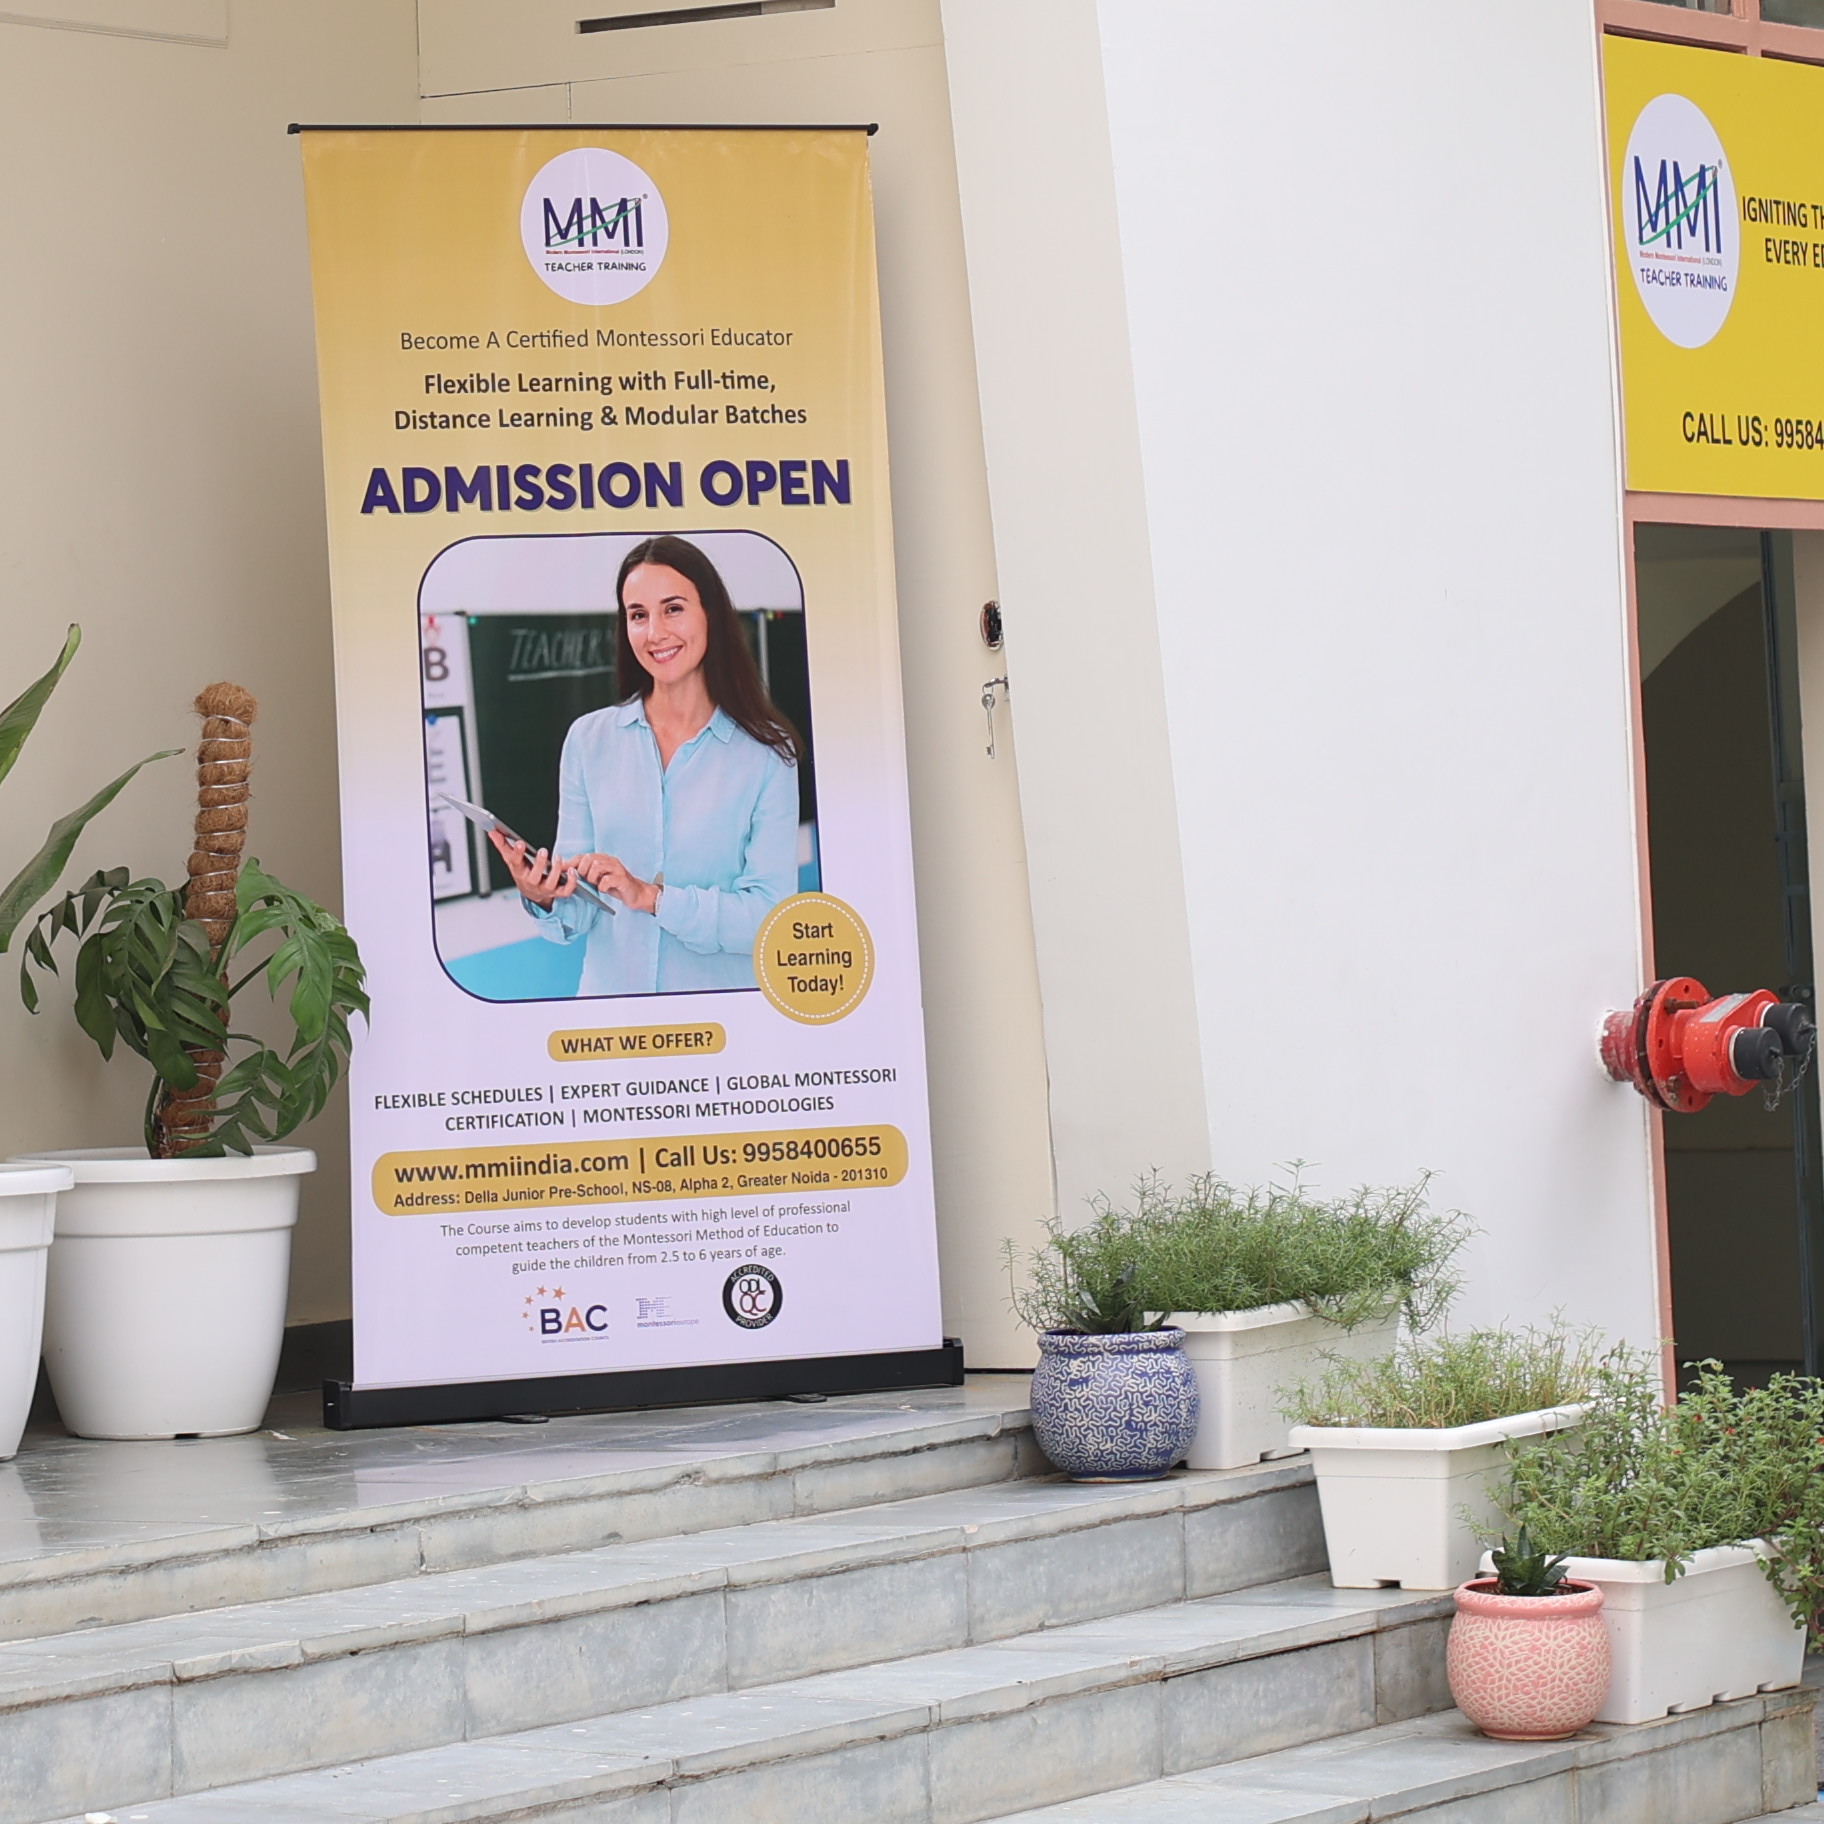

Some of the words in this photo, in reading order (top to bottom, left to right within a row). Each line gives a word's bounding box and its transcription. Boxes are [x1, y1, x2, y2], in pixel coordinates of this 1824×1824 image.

[1634, 155, 1722, 254] MMI
[1743, 196, 1807, 227] IGNITING
[543, 197, 644, 247] MMI
[544, 262, 594, 272] TEACHER
[597, 262, 647, 271] TRAINING
[1765, 238, 1808, 265] EVERY
[1640, 267, 1682, 287] TEACHER
[1684, 273, 1727, 291] TRAINING
[400, 331, 480, 351] Become
[486, 330, 500, 349] A
[506, 328, 588, 349] Certified
[596, 327, 705, 347] Montessori
[710, 327, 793, 346] Educator
[424, 373, 511, 395] Flexible
[518, 372, 613, 396] Learning
[618, 371, 666, 392] with
[674, 369, 776, 393] Full-time,
[394, 408, 491, 430] Distance
[498, 407, 594, 431] Learning
[600, 407, 619, 427] &
[624, 404, 720, 427] Modular
[725, 403, 807, 425] Batches
[1683, 412, 1732, 445] CALL
[1738, 416, 1769, 447] US:
[360, 461, 683, 515] ADMISSION
[699, 458, 852, 507] OPEN
[509, 628, 615, 672] TEACHER'
[792, 922, 833, 939] Start
[776, 949, 852, 969] Learning
[787, 975, 844, 995] Today!
[561, 1037, 614, 1054] WHAT
[619, 1034, 647, 1050] WE
[652, 1031, 713, 1048] OFFER?
[375, 1092, 446, 1110] FLEXIBLE
[451, 1087, 543, 1106] SCHEDULES
[561, 1083, 621, 1100] EXPERT
[626, 1078, 709, 1096] GUIDANCE
[727, 1073, 790, 1091] GLOBAL
[794, 1068, 897, 1088] MONTESSORI
[445, 1111, 564, 1131] CERTIFICATION
[583, 1104, 690, 1123] MONTESSORI
[695, 1096, 834, 1117] METHODOLOGIES
[394, 1153, 629, 1183] www.mmiindia.com
[655, 1146, 694, 1167] Call
[703, 1144, 736, 1165] Us:
[742, 1136, 881, 1162] 9958400655
[394, 1192, 460, 1207] Address:
[465, 1189, 498, 1203] Della
[502, 1187, 545, 1202] Junior
[549, 1182, 628, 1199] Pre-School,
[633, 1179, 676, 1194] NS-08,
[680, 1177, 718, 1193] Alpha
[721, 1176, 733, 1190] 2,
[737, 1173, 787, 1188] Greater
[791, 1170, 829, 1185] Noida
[841, 1167, 888, 1182] 201310
[441, 1224, 464, 1237] The
[467, 1222, 510, 1235] Course
[513, 1220, 542, 1233] aims
[545, 1219, 559, 1231] to
[562, 1216, 611, 1232] develop
[615, 1212, 668, 1227] students
[672, 1209, 698, 1223] with
[701, 1207, 727, 1224] high
[731, 1206, 758, 1220] level
[762, 1205, 775, 1218] of
[778, 1200, 851, 1218] professional
[455, 1241, 522, 1257] competent
[526, 1238, 579, 1253] teachers
[583, 1236, 596, 1249] of
[598, 1235, 619, 1248] the
[623, 1230, 692, 1246] Montessori
[695, 1226, 744, 1241] Method
[747, 1224, 760, 1238] of
[763, 1221, 823, 1237] Education
[826, 1221, 839, 1233] to
[512, 1259, 546, 1275] guide
[550, 1258, 571, 1271] the
[573, 1254, 624, 1269] children
[627, 1251, 657, 1267] from
[661, 1250, 680, 1264] 2.5
[683, 1250, 696, 1262] to
[699, 1248, 707, 1261] 6
[709, 1246, 742, 1263] years
[745, 1244, 758, 1259] of
[761, 1246, 786, 1260] age.
[730, 1265, 774, 1283] ACCREDITED
[540, 1304, 608, 1335] BAC
[736, 1313, 773, 1327] PROVIDER
